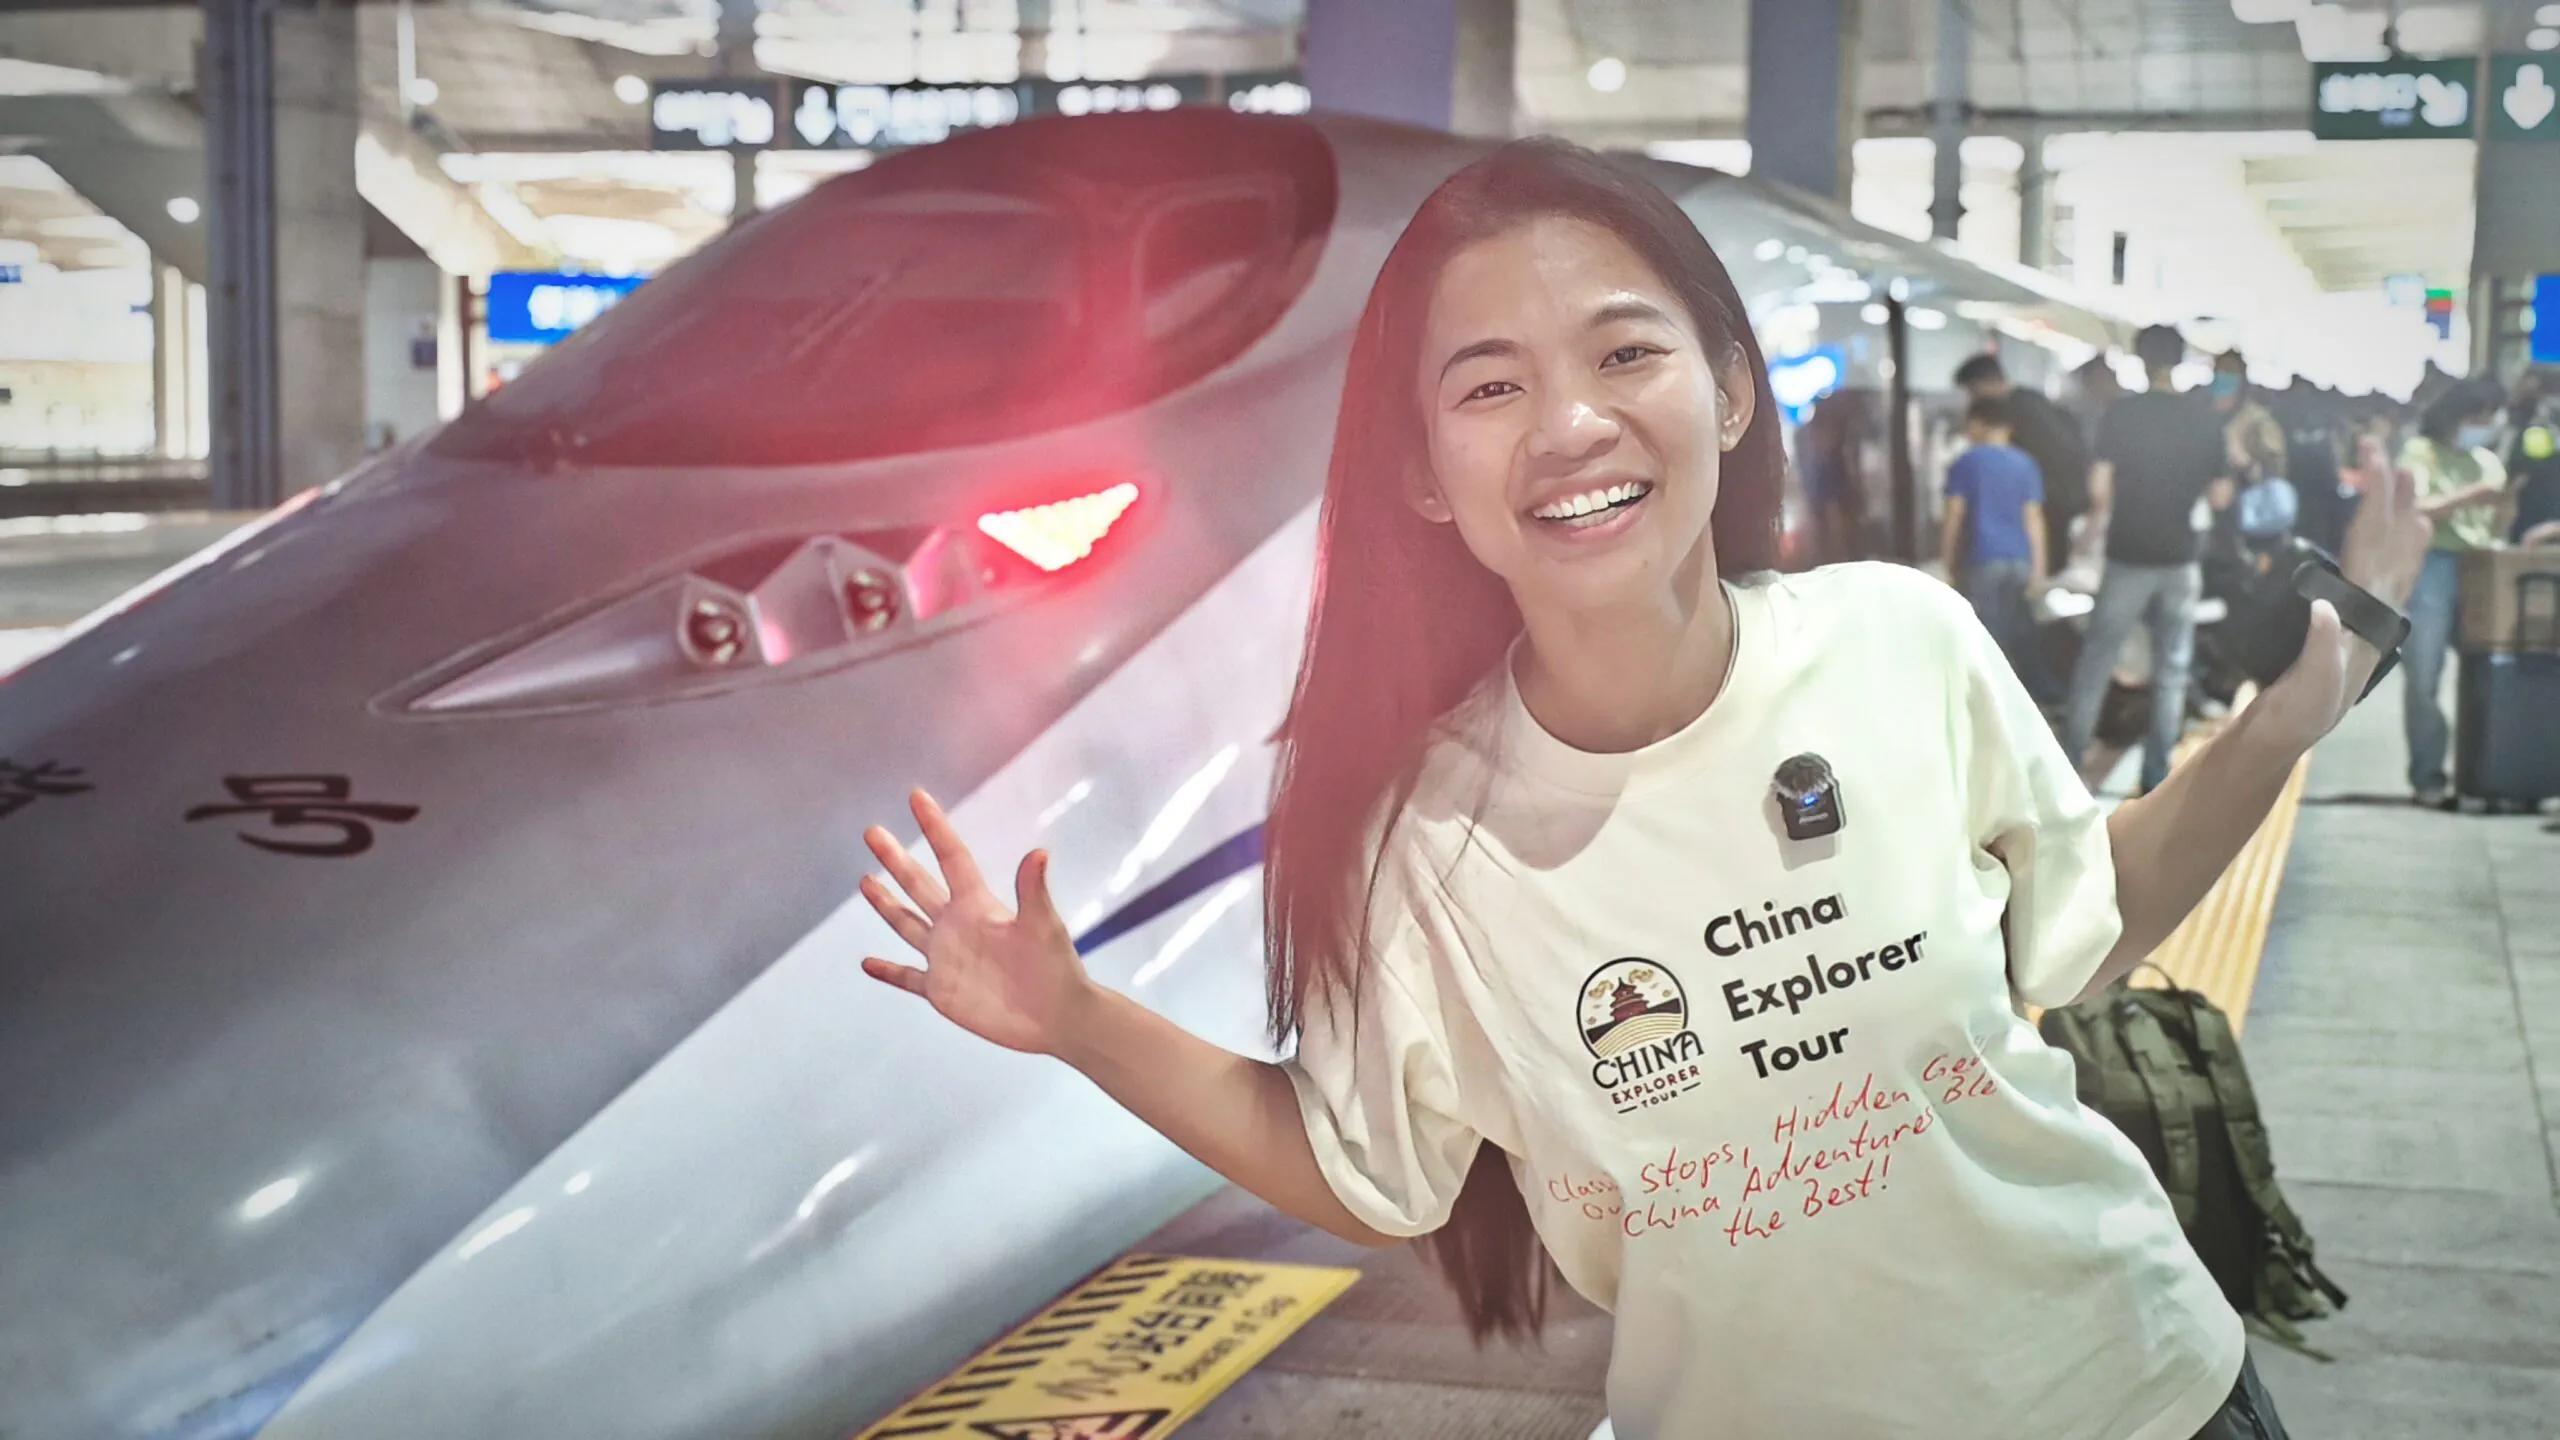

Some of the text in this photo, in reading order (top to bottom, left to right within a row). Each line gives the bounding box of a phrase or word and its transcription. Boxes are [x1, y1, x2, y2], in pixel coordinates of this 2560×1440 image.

[1704, 893, 1847, 957] China
[1721, 931, 1927, 1022] Explorer
[1592, 1030, 1705, 1089] CHINA
[1611, 1065, 1701, 1105] EXPLORER
[1740, 1027, 1849, 1079] Tour
[1641, 1090, 1678, 1108] TOUR
[1775, 1073, 1911, 1144] Hidden
[1582, 1073, 1998, 1237] Ou China Adventures Ble
[1723, 1154, 1890, 1247] the Best!
